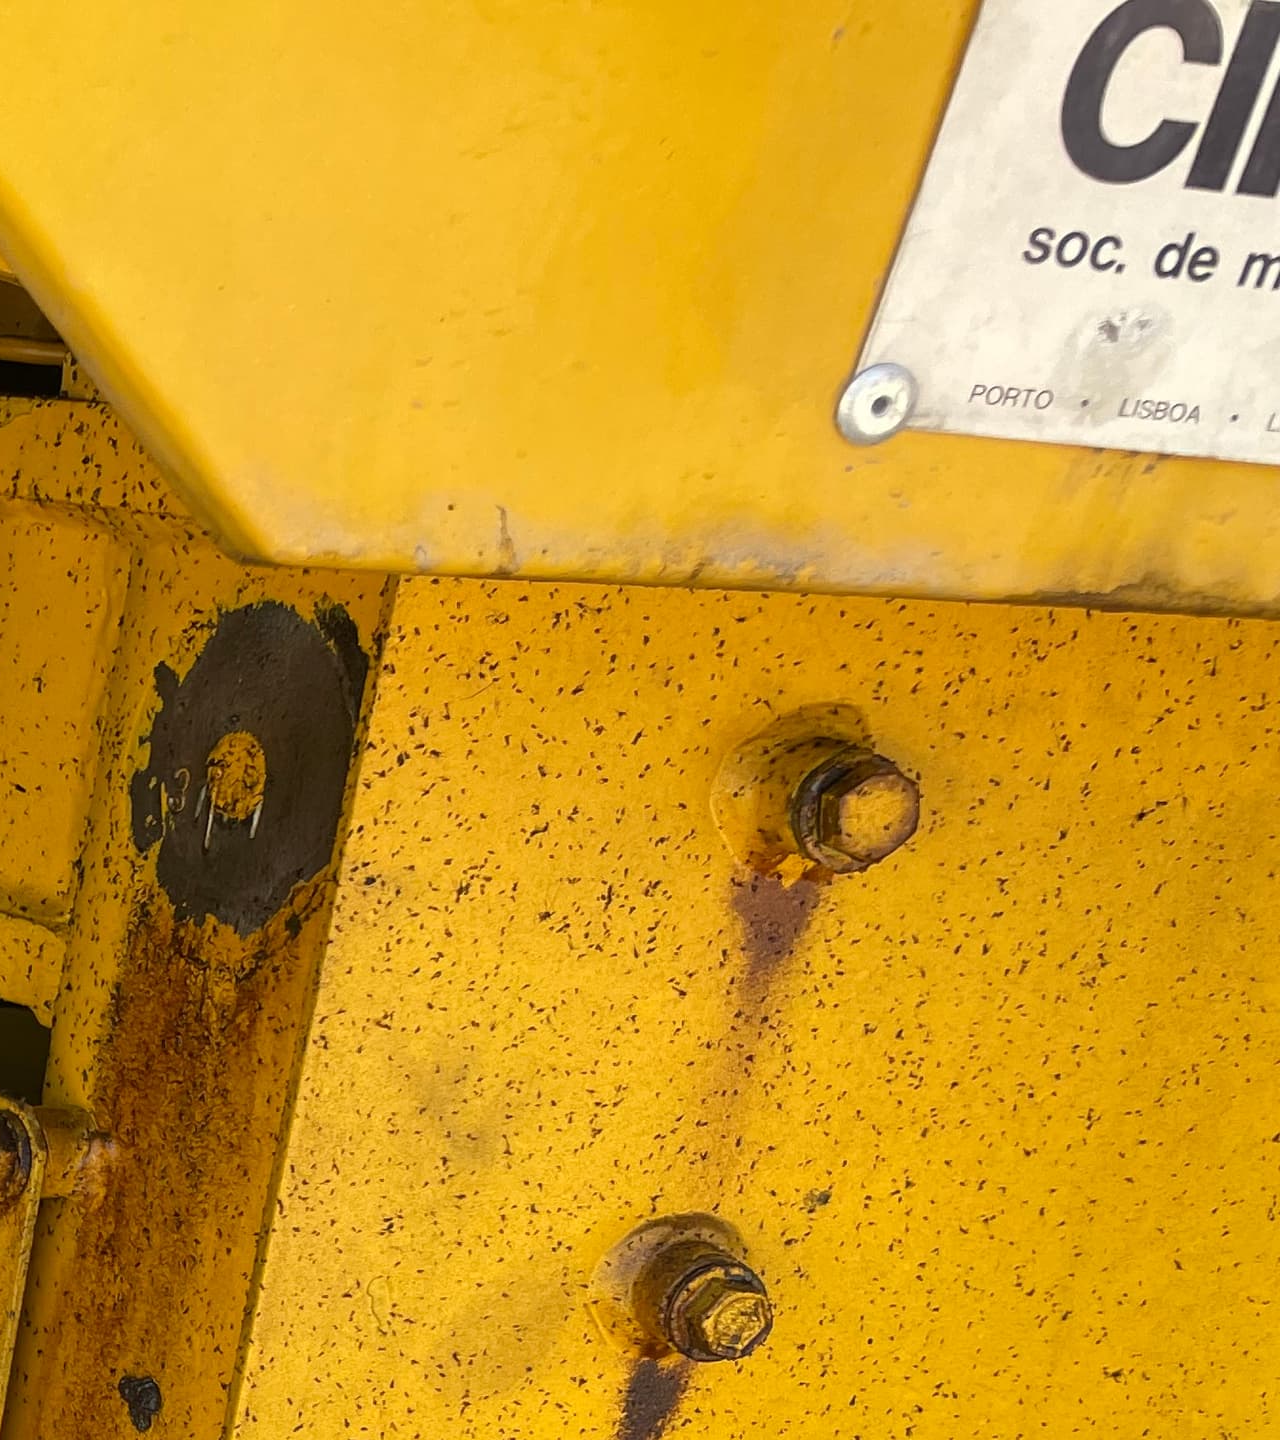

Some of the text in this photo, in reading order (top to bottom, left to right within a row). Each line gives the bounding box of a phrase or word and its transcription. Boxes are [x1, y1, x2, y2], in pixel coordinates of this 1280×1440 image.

[1023, 227, 1126, 274] soc.
[1154, 232, 1219, 282] de
[968, 384, 1054, 409] PORTO
[1117, 398, 1200, 424] LISBOA
